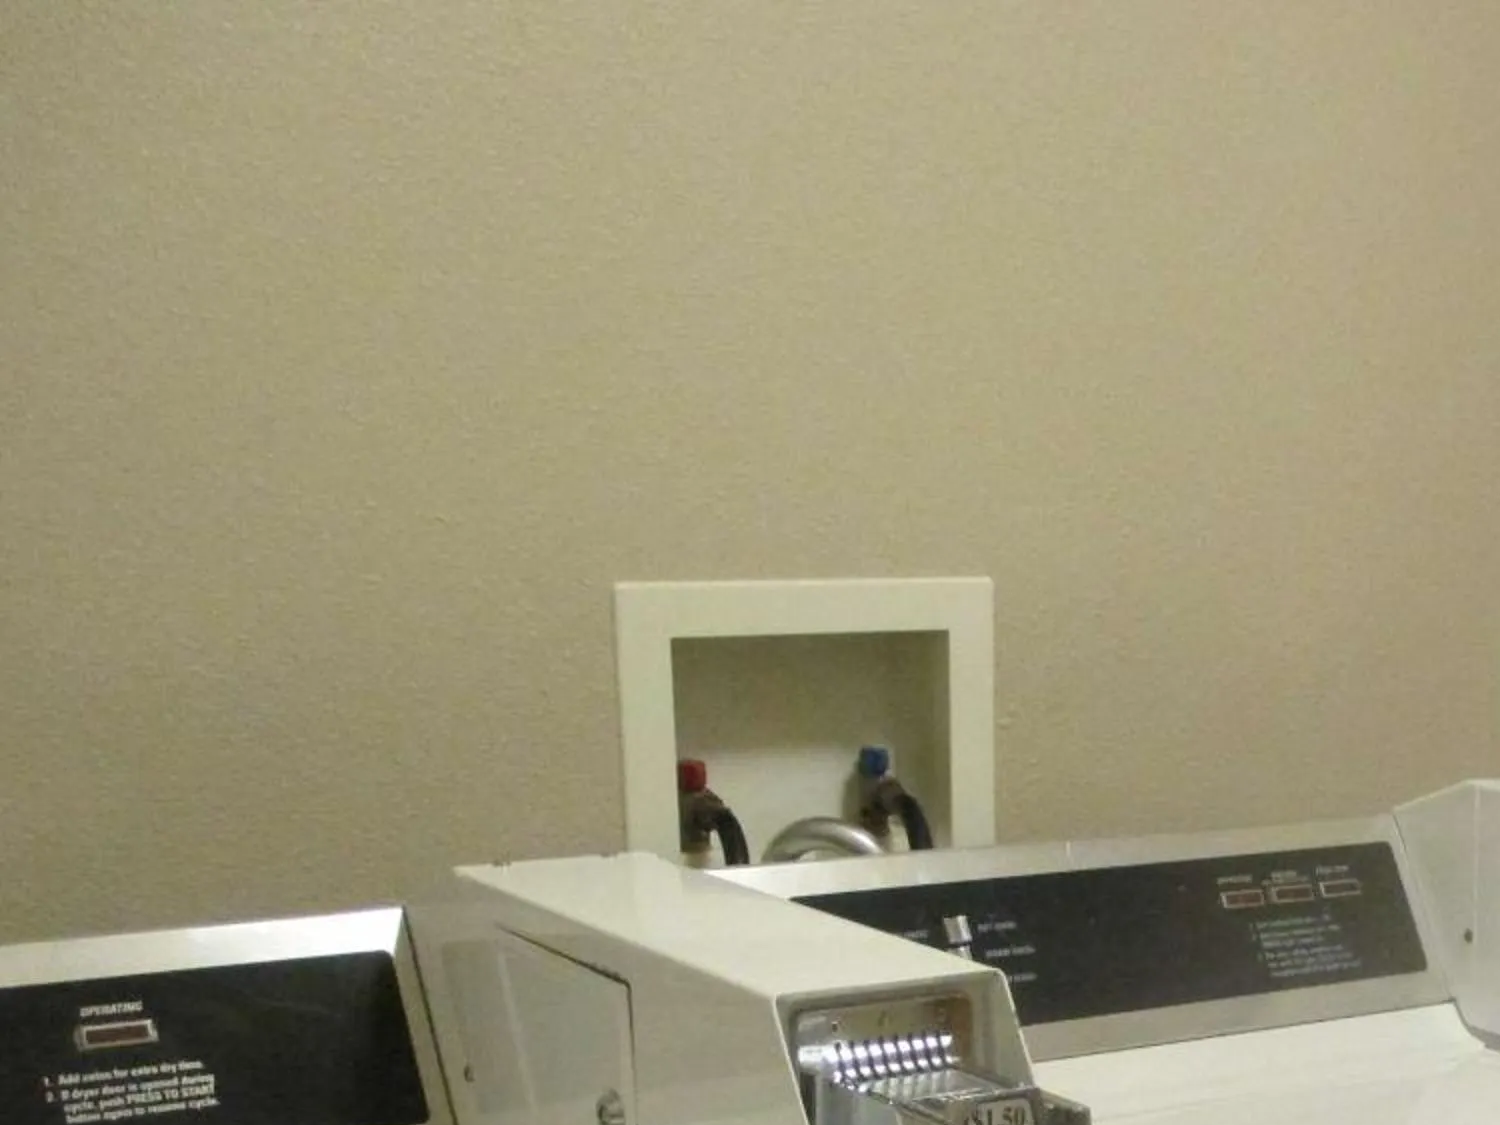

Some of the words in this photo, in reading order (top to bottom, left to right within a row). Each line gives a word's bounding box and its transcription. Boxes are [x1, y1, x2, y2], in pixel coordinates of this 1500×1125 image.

[58, 1073, 80, 1085] Add
[160, 1062, 177, 1074] dry
[71, 1087, 99, 1100] dryer
[98, 1096, 125, 1110] push
